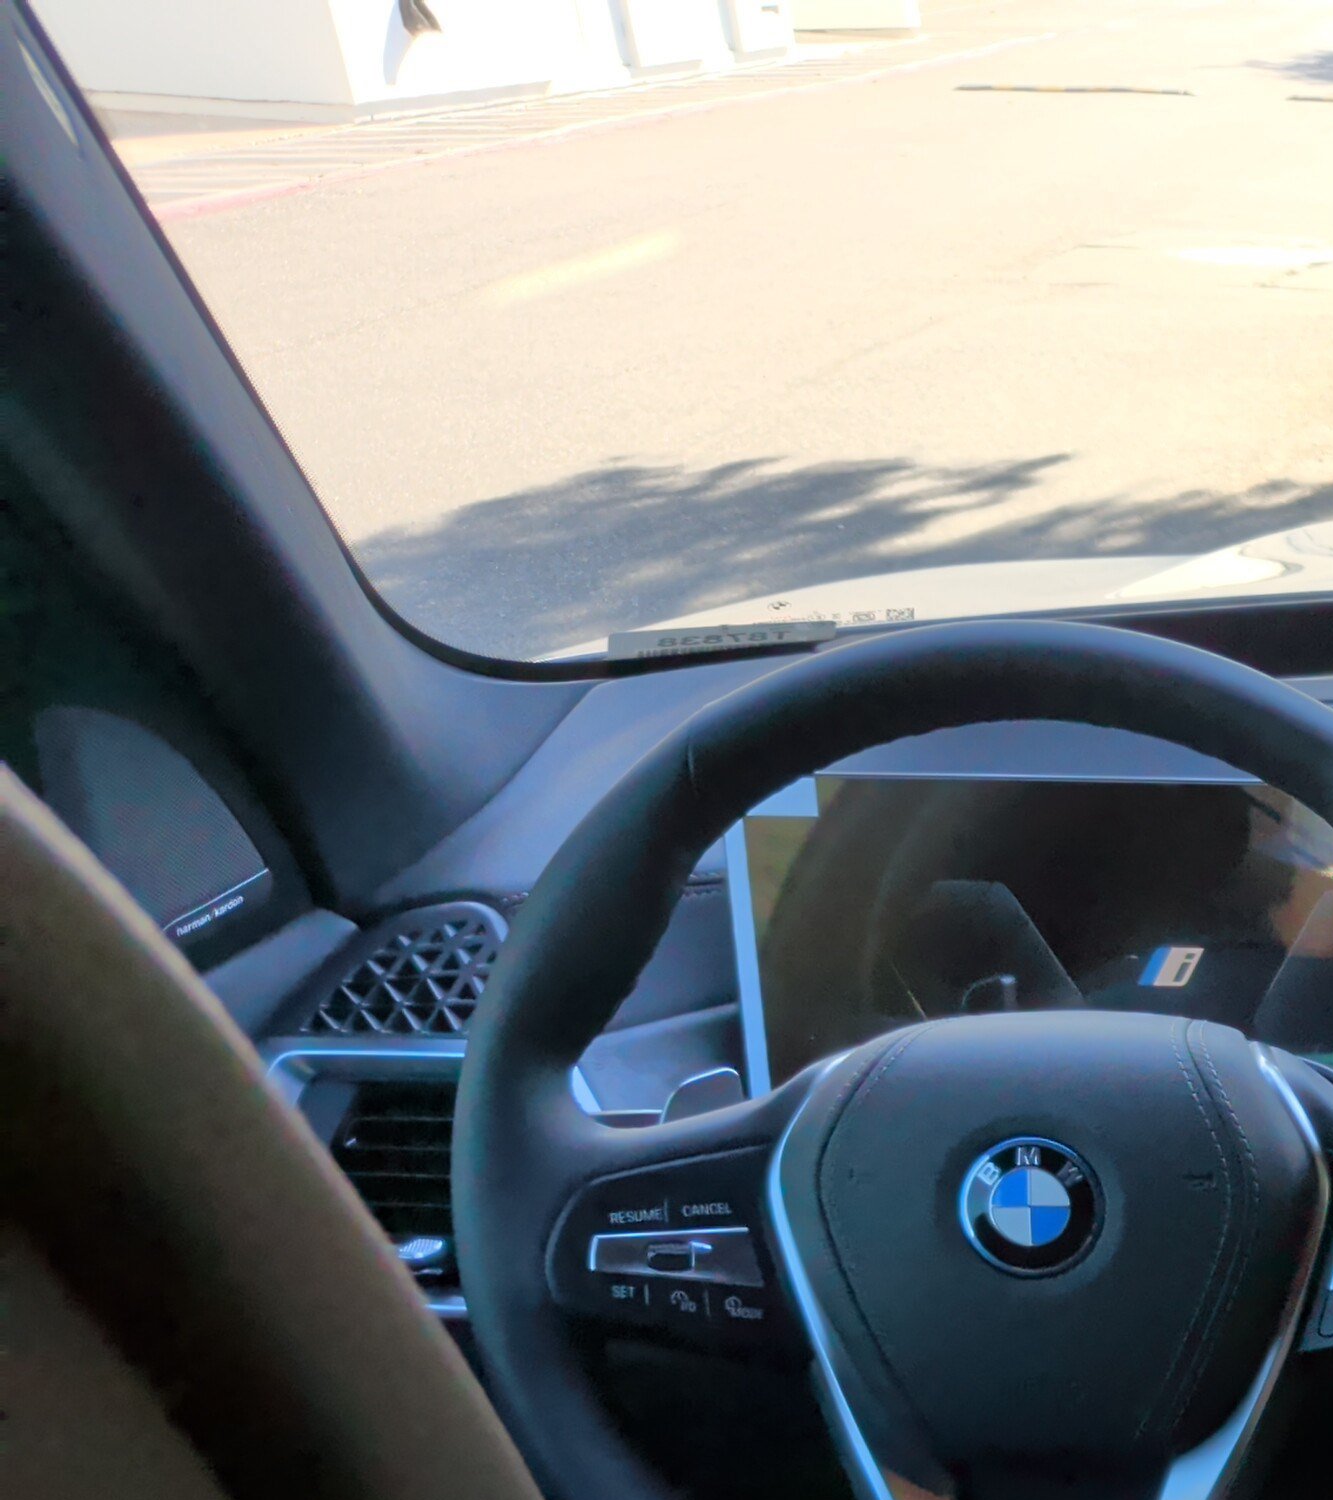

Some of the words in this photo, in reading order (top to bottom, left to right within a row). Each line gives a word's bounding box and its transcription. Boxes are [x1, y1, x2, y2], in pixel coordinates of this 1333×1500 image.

[609, 1208, 664, 1224] RESUME
[681, 1201, 733, 1217] CANCEL
[612, 1285, 636, 1299] SET
